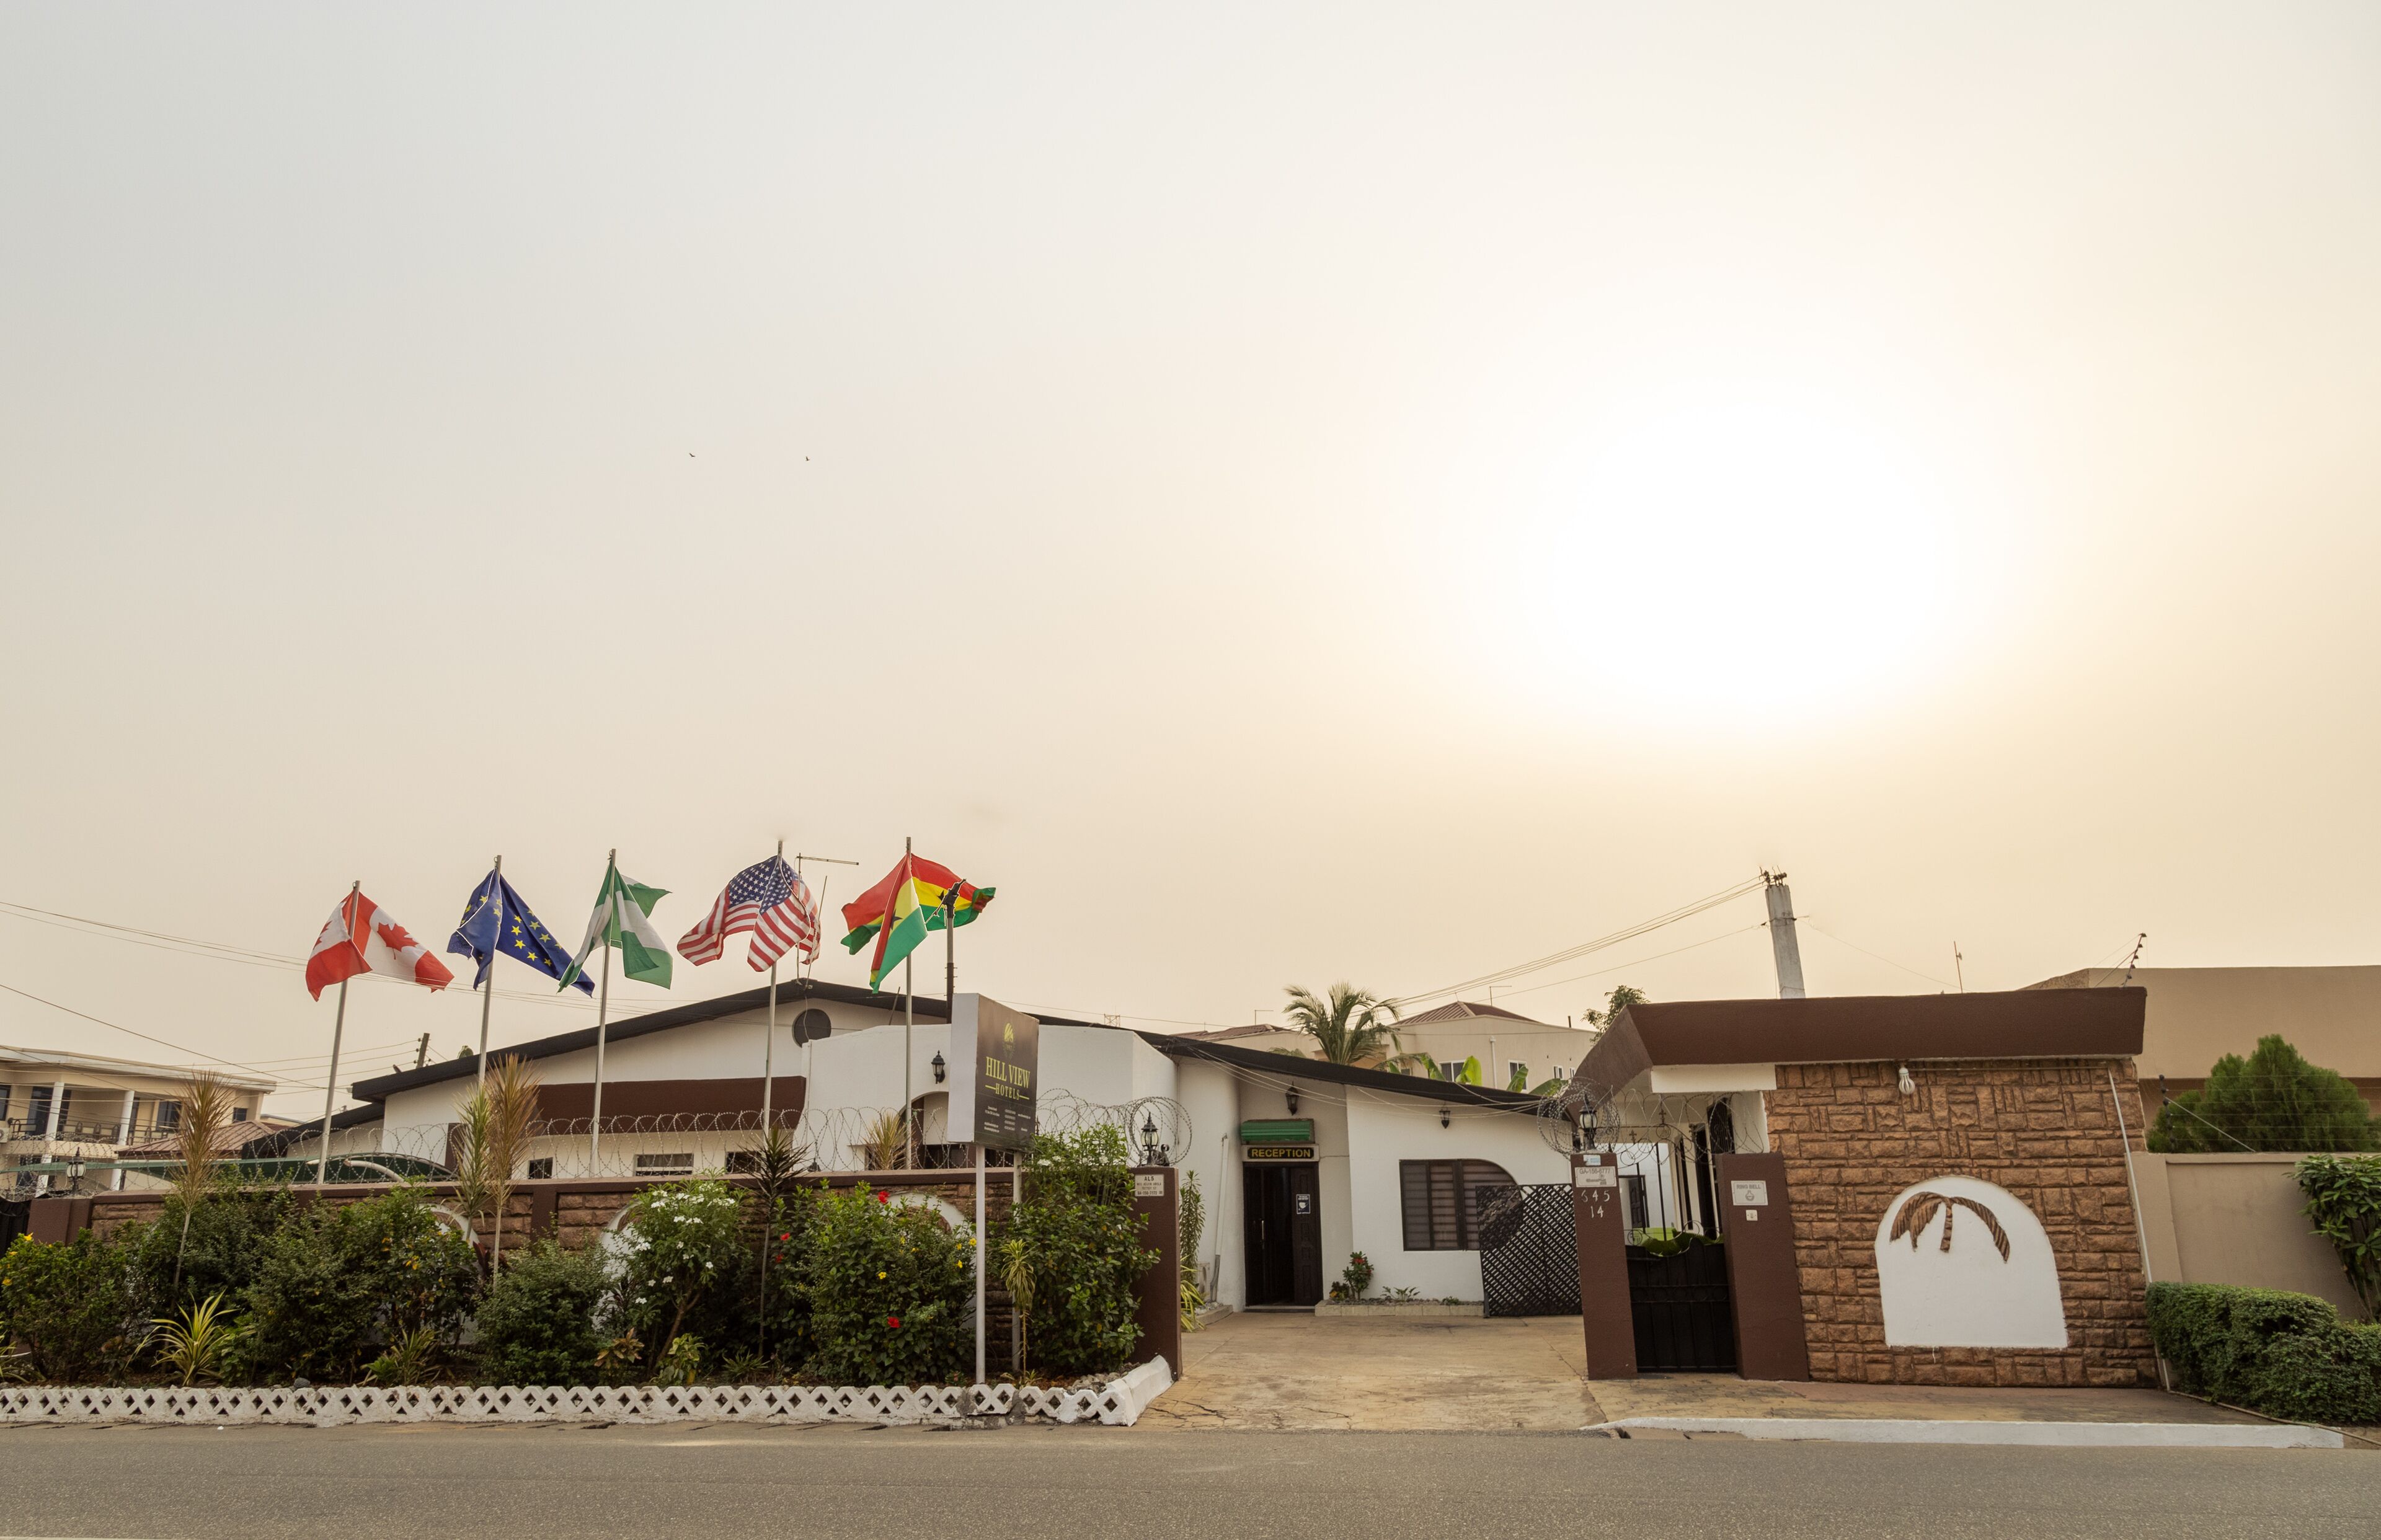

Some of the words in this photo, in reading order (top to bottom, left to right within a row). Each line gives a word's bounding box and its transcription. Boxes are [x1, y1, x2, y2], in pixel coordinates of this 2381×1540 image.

[985, 1056, 1007, 1082] HILL
[1008, 1064, 1031, 1089] VIEW
[995, 1083, 1020, 1100] HOTELS
[1251, 1149, 1311, 1157] RECEPTION
[1590, 1205, 1604, 1219] 14
